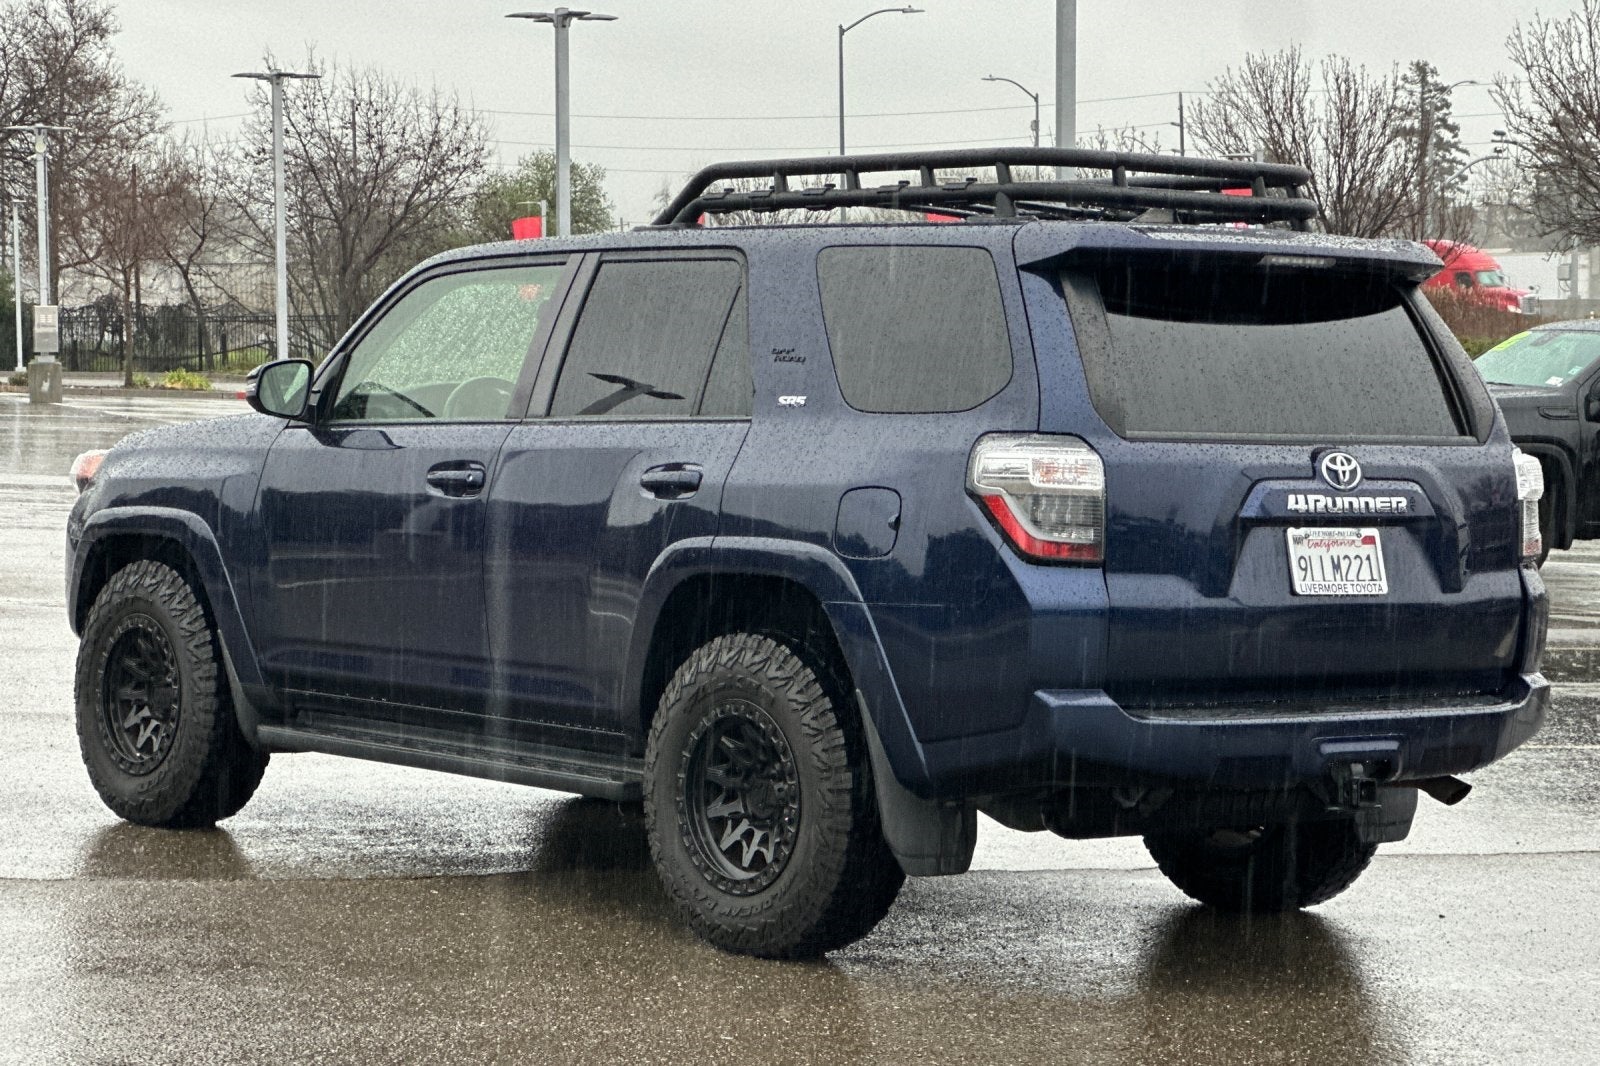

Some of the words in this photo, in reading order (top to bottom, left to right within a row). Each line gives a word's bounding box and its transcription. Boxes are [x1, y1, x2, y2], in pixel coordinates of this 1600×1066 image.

[1307, 538, 1362, 553] California
[1300, 583, 1348, 593] LIVERMORE
[1351, 583, 1384, 592] TOYOTA
